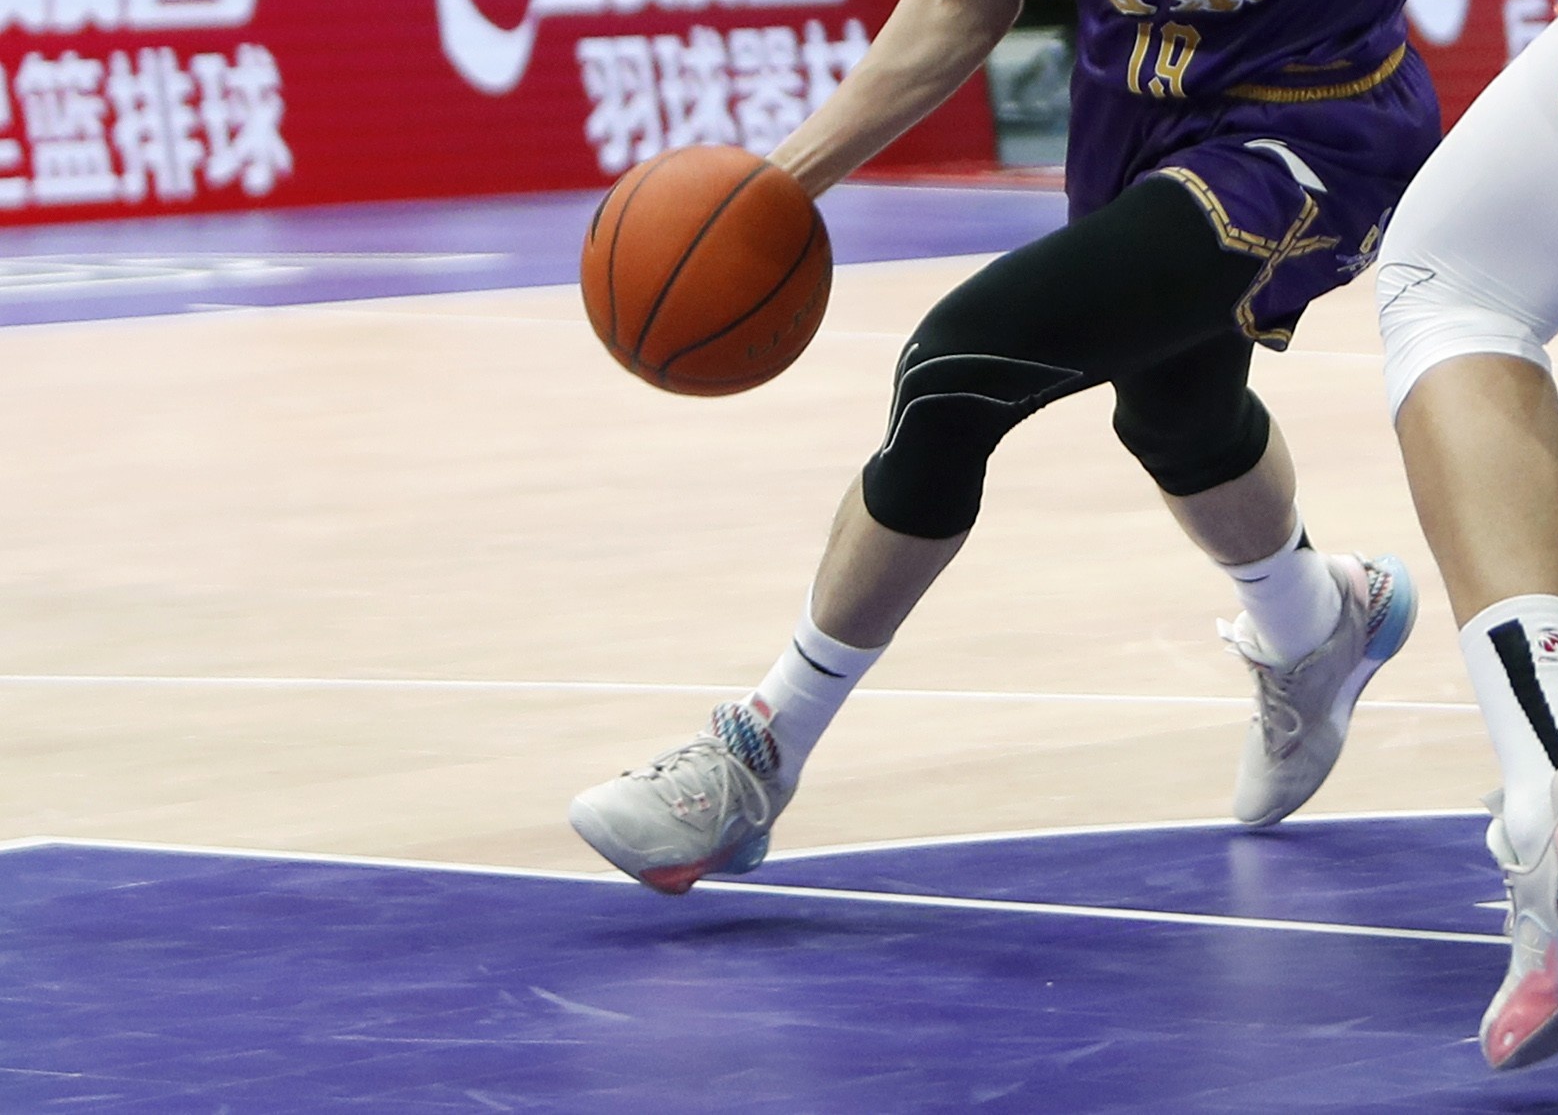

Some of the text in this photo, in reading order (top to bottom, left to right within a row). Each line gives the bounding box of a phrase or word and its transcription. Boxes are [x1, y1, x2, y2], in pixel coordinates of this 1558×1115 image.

[1126, 21, 1201, 98] 19
[0, 44, 294, 209] 篮排球
